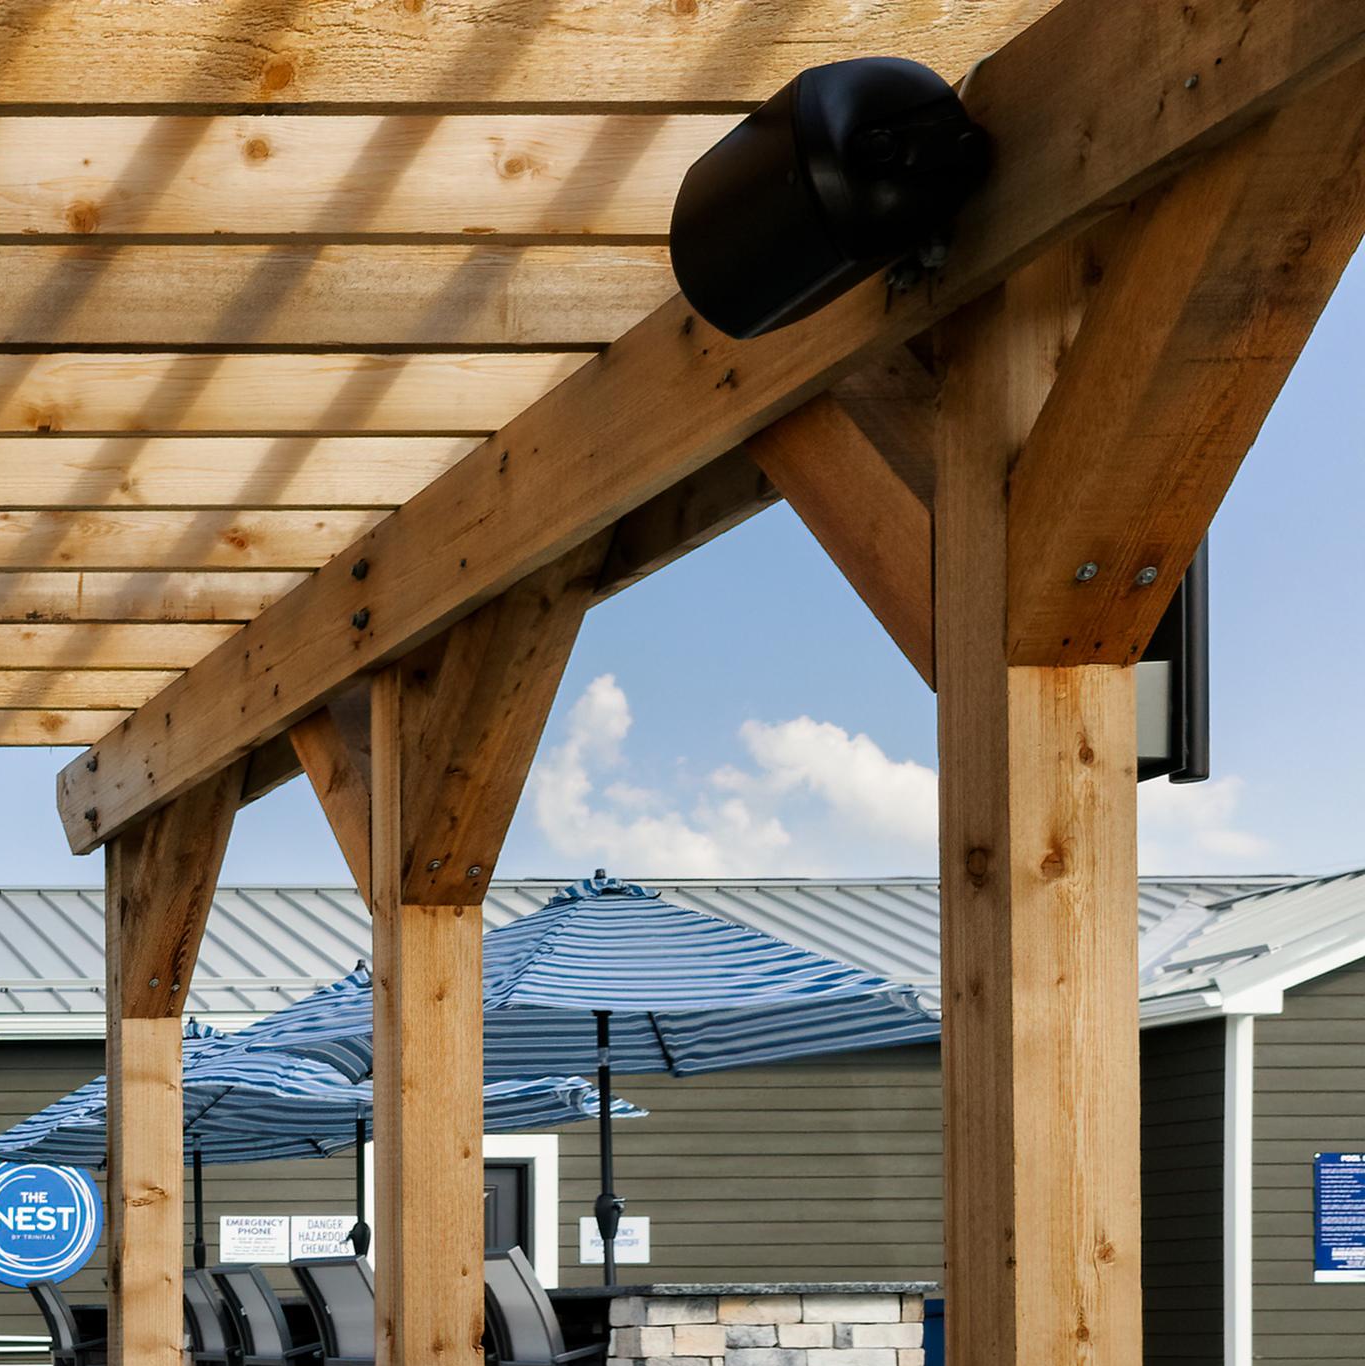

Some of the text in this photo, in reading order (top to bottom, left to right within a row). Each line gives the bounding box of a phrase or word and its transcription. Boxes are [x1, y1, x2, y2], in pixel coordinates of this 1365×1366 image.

[20, 1191, 49, 1204] THE
[225, 1218, 284, 1227] EMERGENCY
[307, 1219, 342, 1230] DANGER
[237, 1227, 271, 1235] PHONE
[298, 1231, 352, 1241] HAZARDOU
[301, 1243, 350, 1254] CHEMICALS
